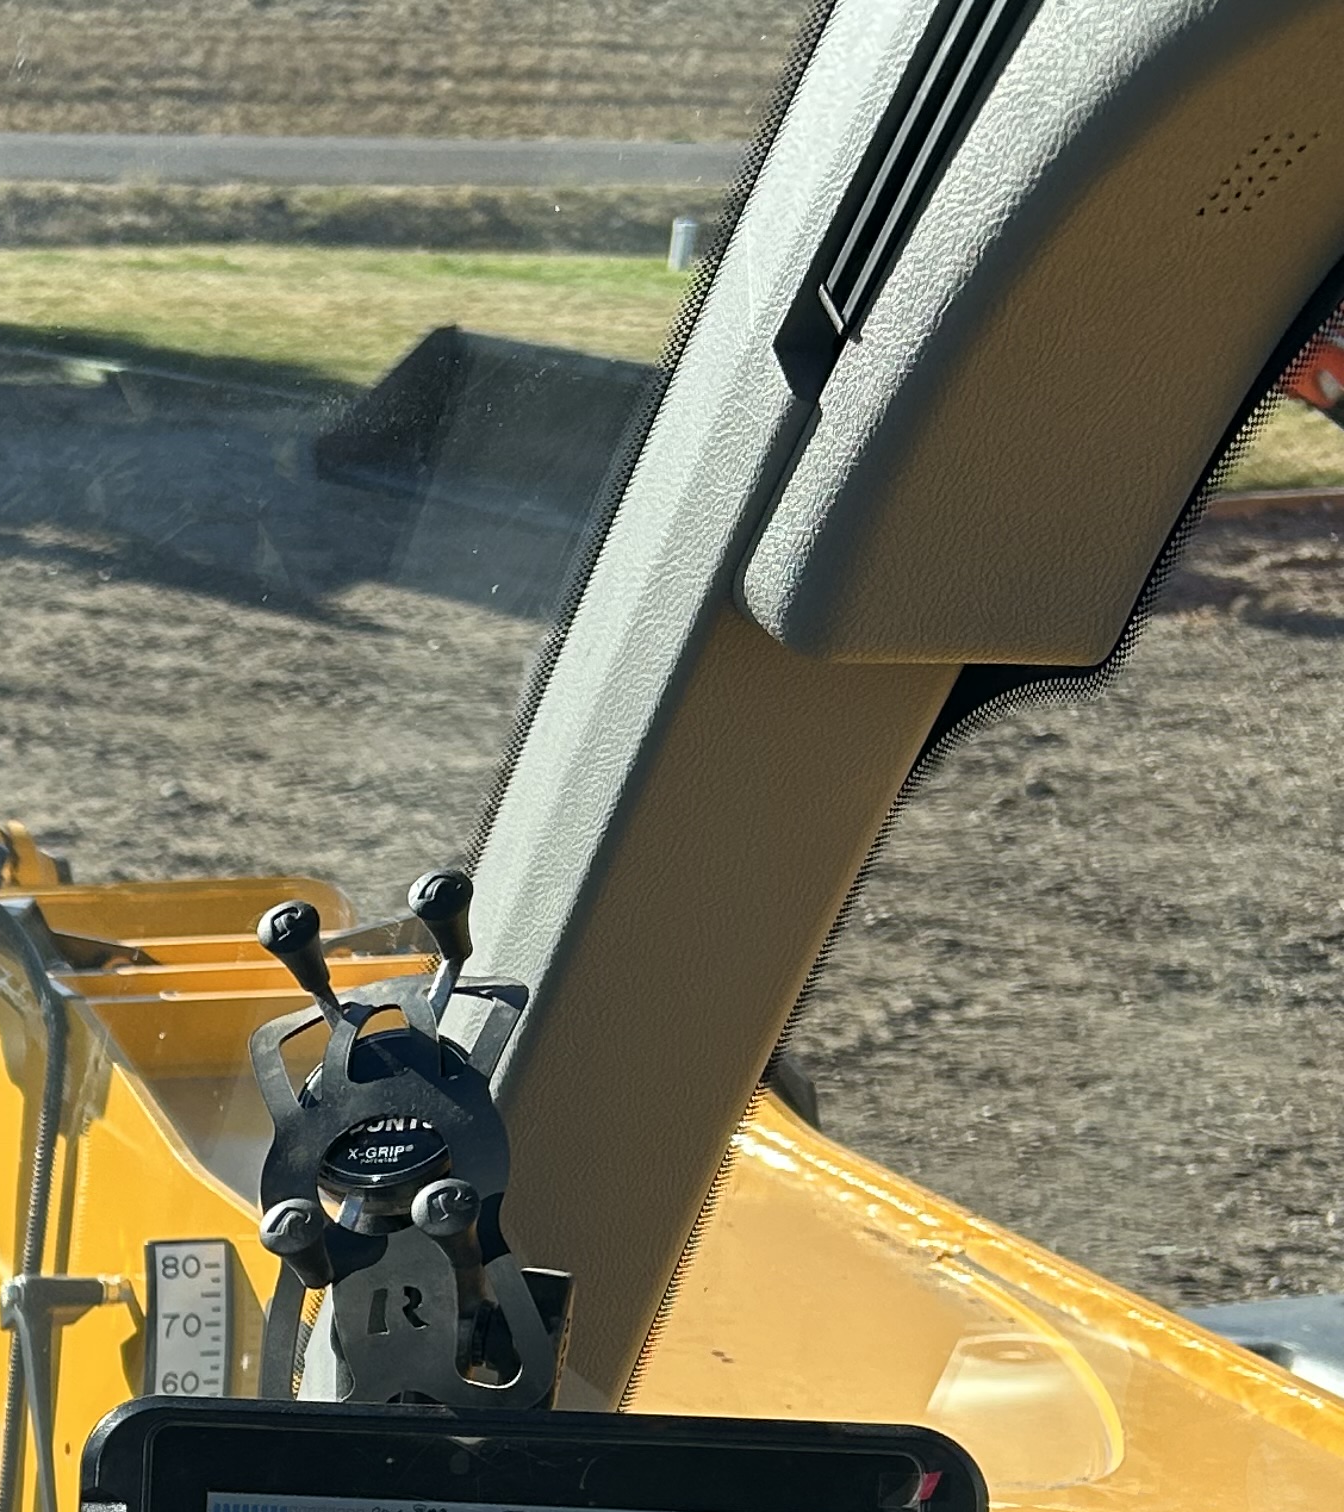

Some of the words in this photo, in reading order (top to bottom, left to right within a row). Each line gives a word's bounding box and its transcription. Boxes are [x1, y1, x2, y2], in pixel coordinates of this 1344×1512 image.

[161, 1255, 201, 1279] 80
[162, 1313, 202, 1337] 70
[162, 1372, 200, 1394] 60
